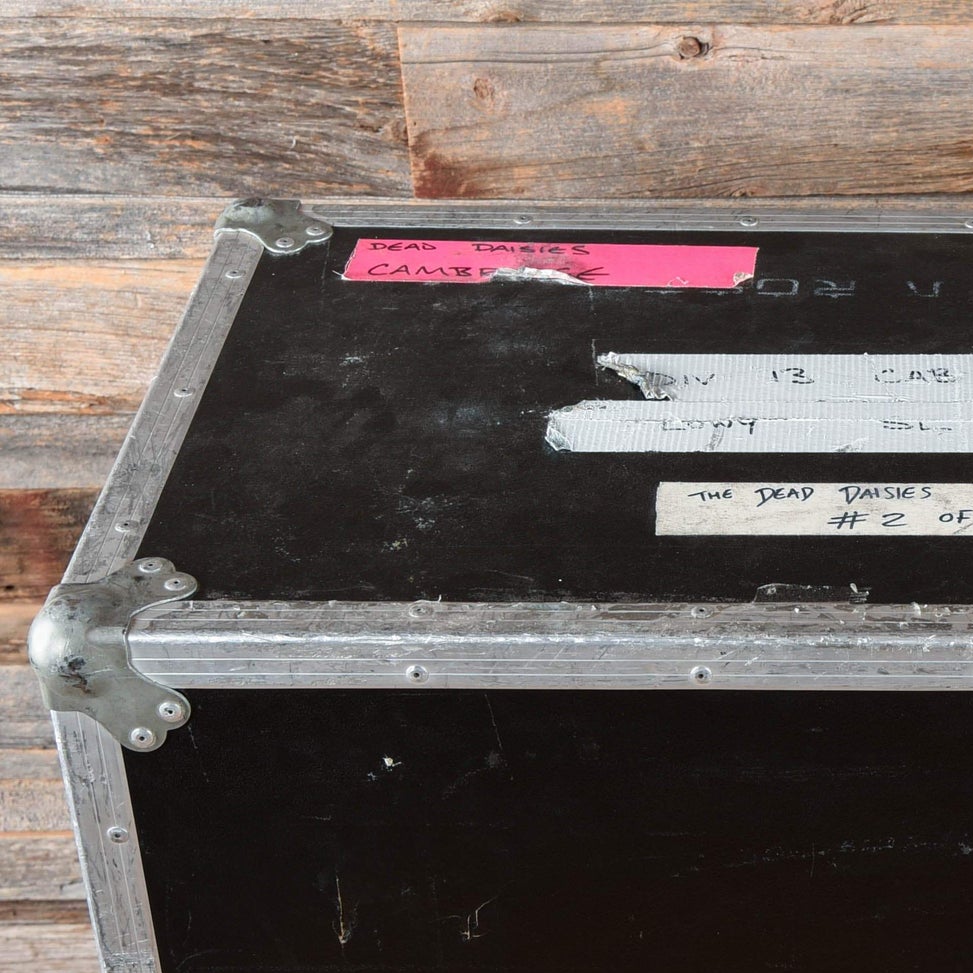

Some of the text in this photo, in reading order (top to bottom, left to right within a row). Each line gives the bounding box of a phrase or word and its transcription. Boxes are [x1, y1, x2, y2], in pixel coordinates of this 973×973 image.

[367, 241, 591, 256] DEAD DAISIES
[367, 262, 610, 281] CAMBE
[770, 367, 815, 385] 13
[687, 485, 933, 508] THE DEAD DAISIES
